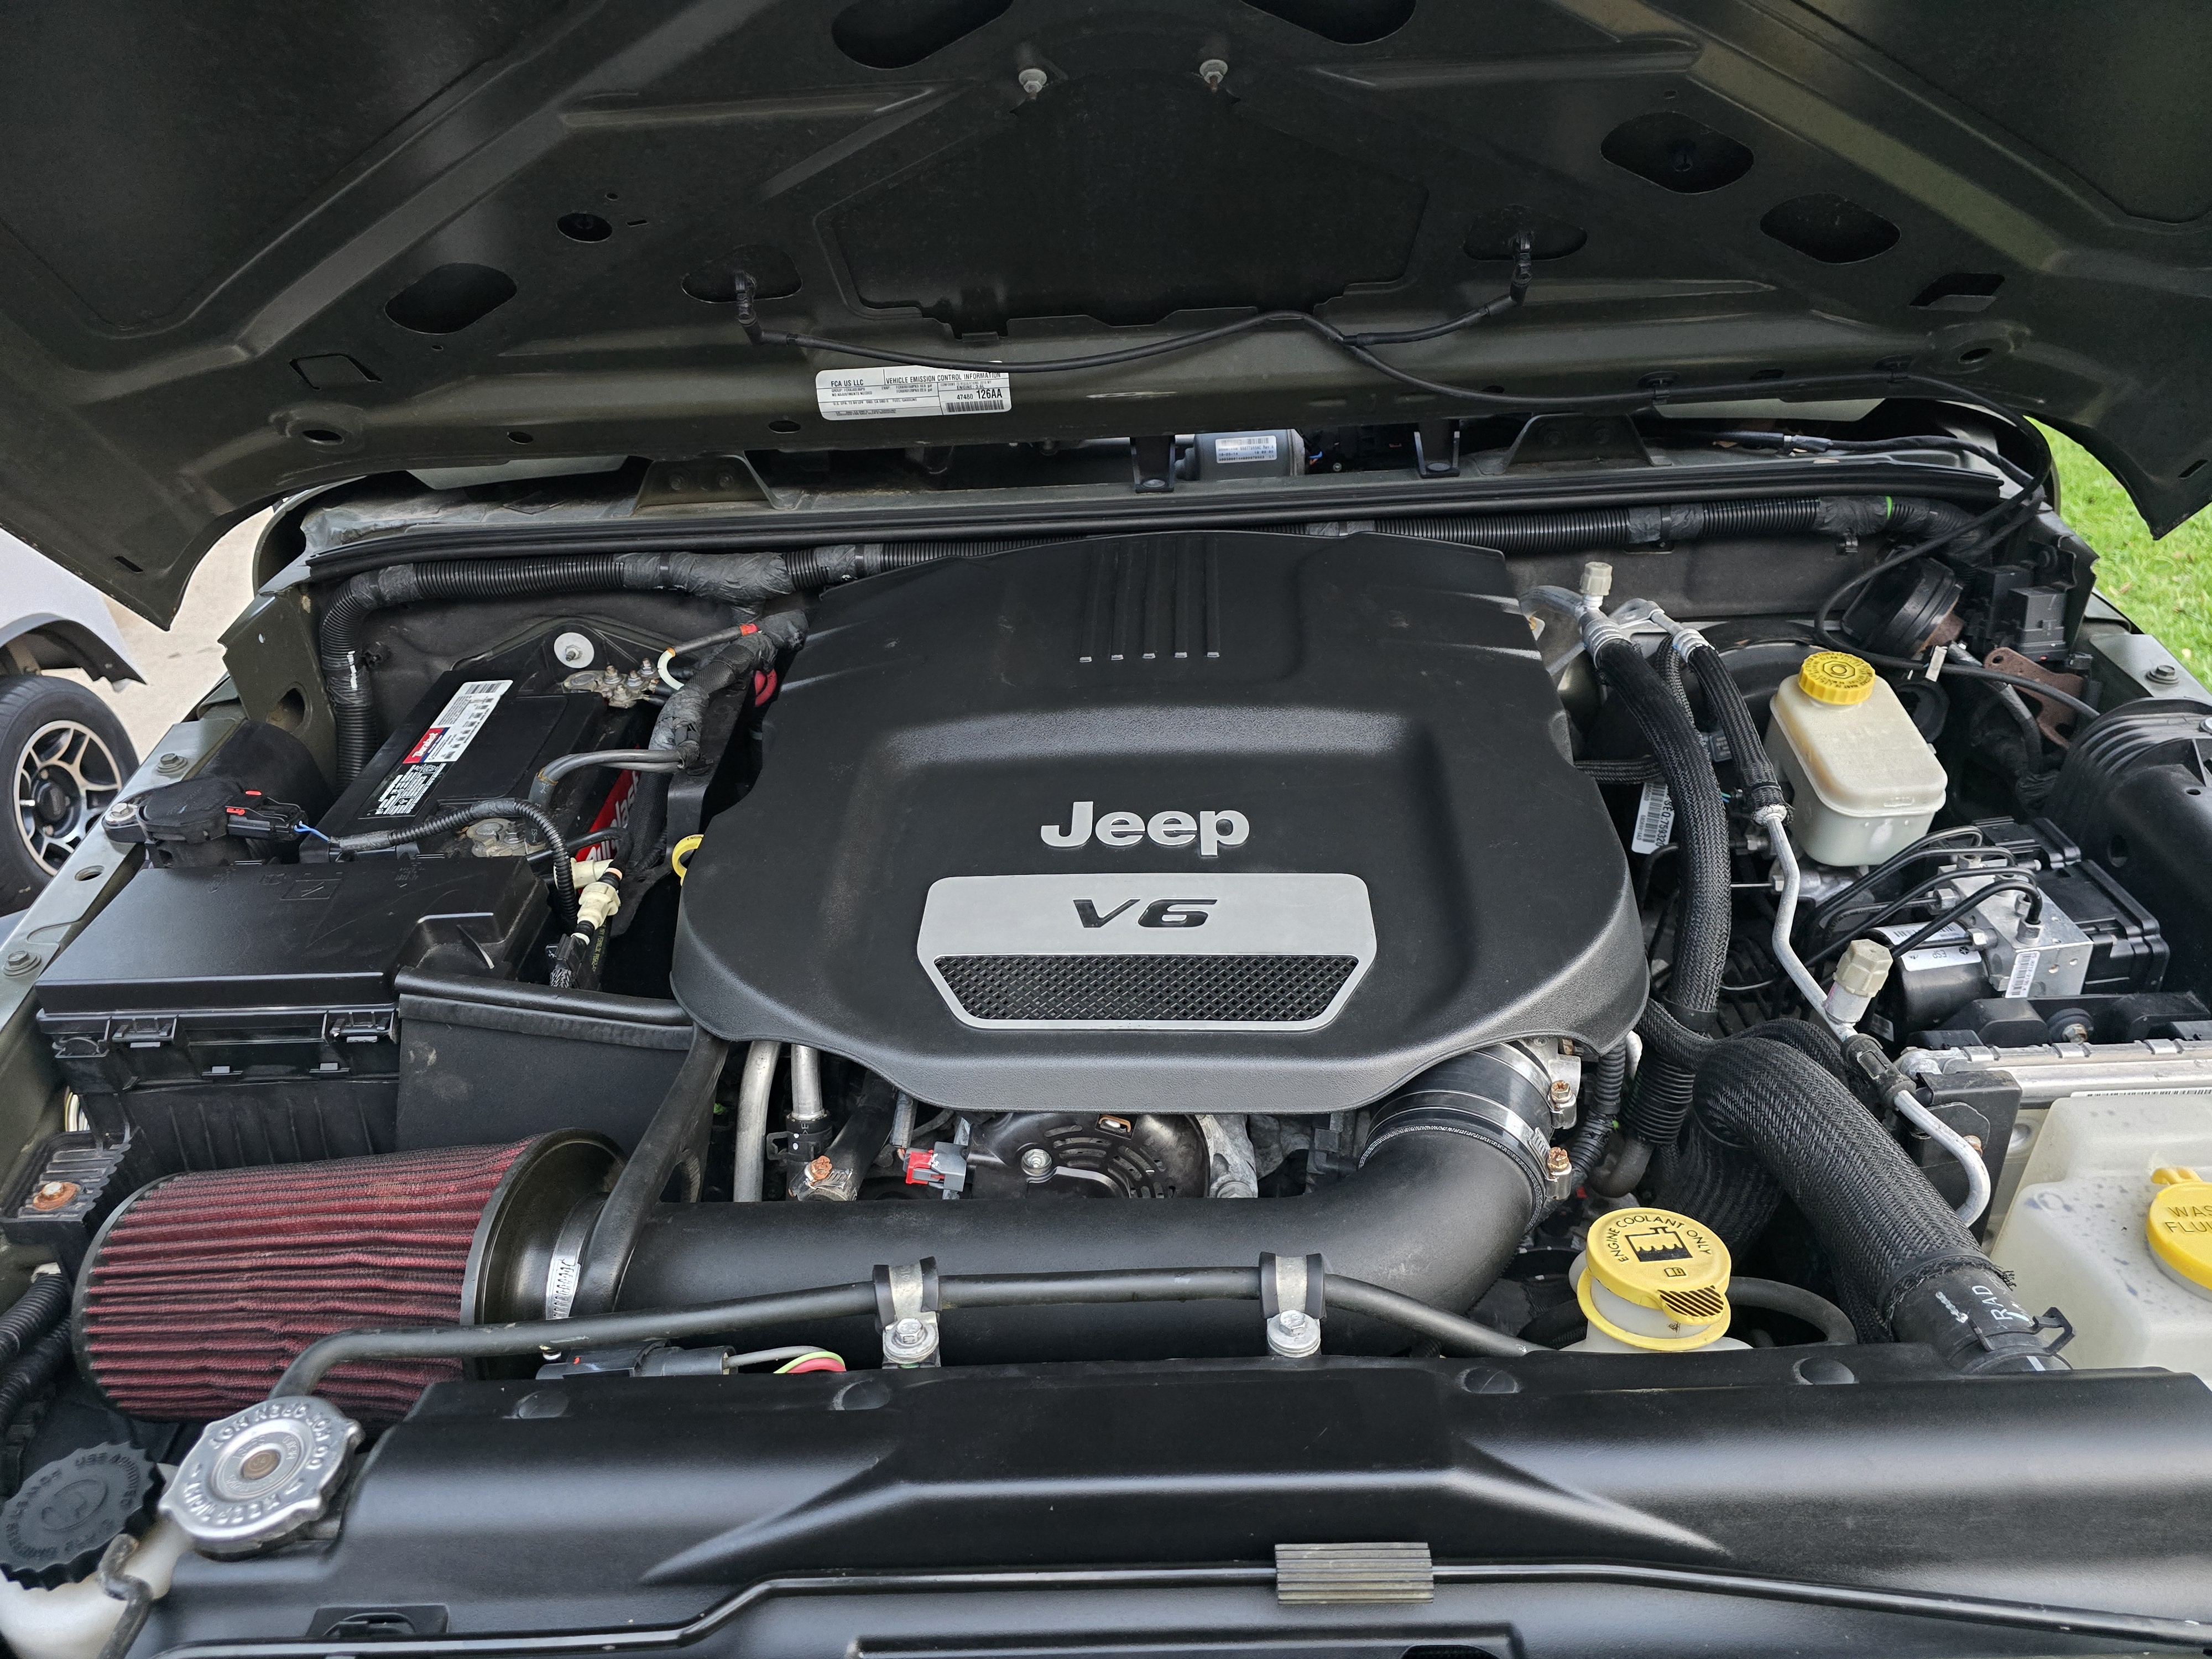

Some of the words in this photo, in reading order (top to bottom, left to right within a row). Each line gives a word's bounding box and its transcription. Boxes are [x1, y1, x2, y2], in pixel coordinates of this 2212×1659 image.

[976, 388, 1003, 399] 126AA
[411, 732, 439, 758] Duralast
[1041, 801, 1250, 857] Jeep
[1073, 898, 1218, 928] V6
[1933, 950, 1947, 958] ESP
[1616, 1215, 1685, 1229] COOLANT
[1606, 1227, 1630, 1262] ENGINE
[1687, 1230, 1712, 1255] ONLY
[1971, 1285, 2013, 1321] RAD
